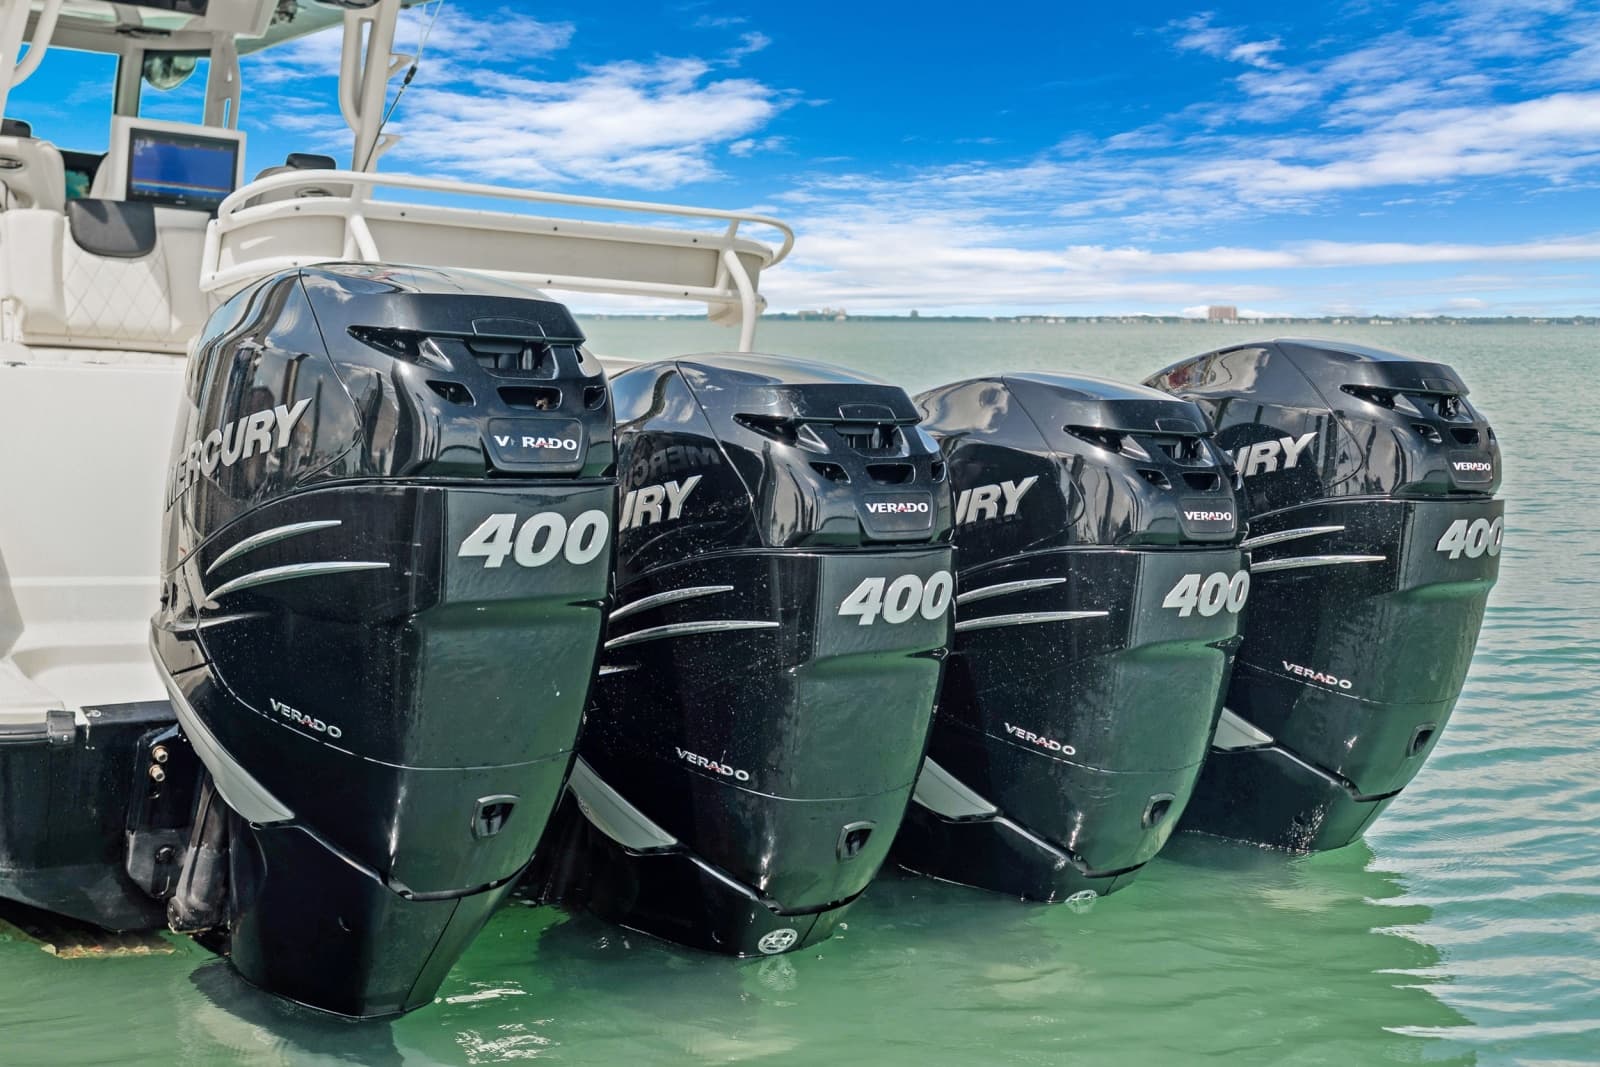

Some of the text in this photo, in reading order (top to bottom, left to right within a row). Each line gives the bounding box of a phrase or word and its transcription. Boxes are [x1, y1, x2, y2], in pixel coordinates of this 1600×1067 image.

[494, 435, 577, 451] VRADO
[1224, 431, 1319, 477] RY
[1453, 461, 1492, 472] VERADO
[619, 474, 703, 532] RY
[865, 502, 929, 513] VERADO
[956, 475, 1039, 526] RY
[1184, 511, 1232, 521] VERADO
[457, 509, 610, 569] 400
[1436, 516, 1505, 560] 400
[838, 570, 954, 626] 400
[1162, 569, 1250, 617] 400
[1282, 660, 1353, 690] VERADO
[270, 697, 342, 738] VERADO
[1004, 722, 1076, 755] VERADO
[675, 746, 750, 781] VERADO
